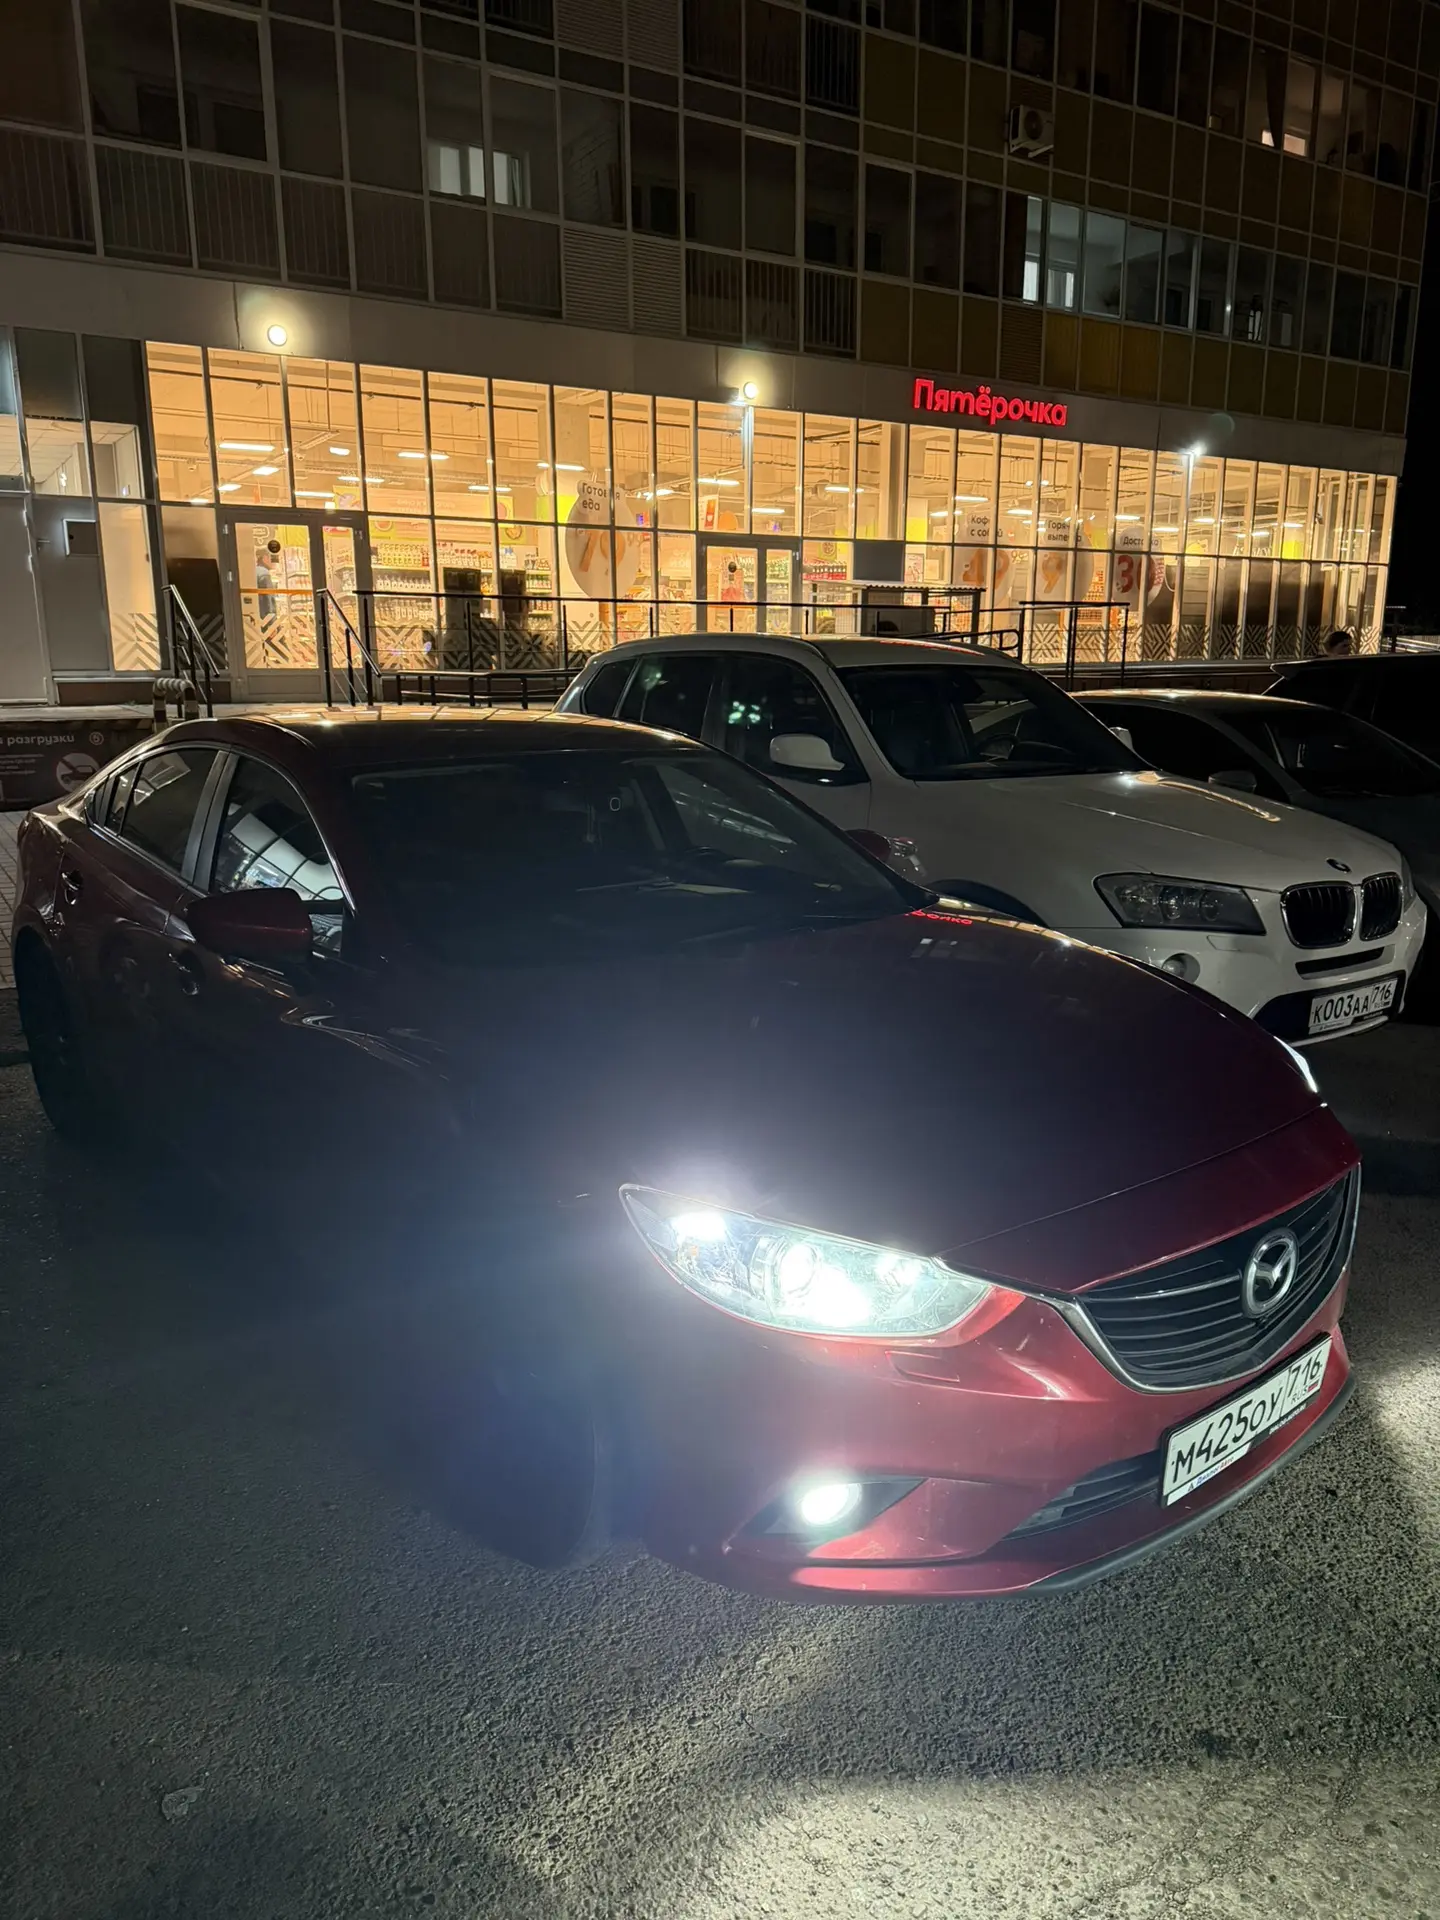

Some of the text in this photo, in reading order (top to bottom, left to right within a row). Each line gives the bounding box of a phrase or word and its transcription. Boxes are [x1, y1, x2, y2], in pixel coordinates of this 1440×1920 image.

[914, 378, 1068, 427] Пятёрочка
[582, 482, 620, 500] Готовя
[582, 498, 600, 511] еда
[971, 515, 992, 526] Коф
[7, 734, 75, 747] разгрузки
[1372, 983, 1392, 1004] 716
[1173, 1386, 1283, 1484] М425ОУ
[1288, 1350, 1322, 1398] 716
